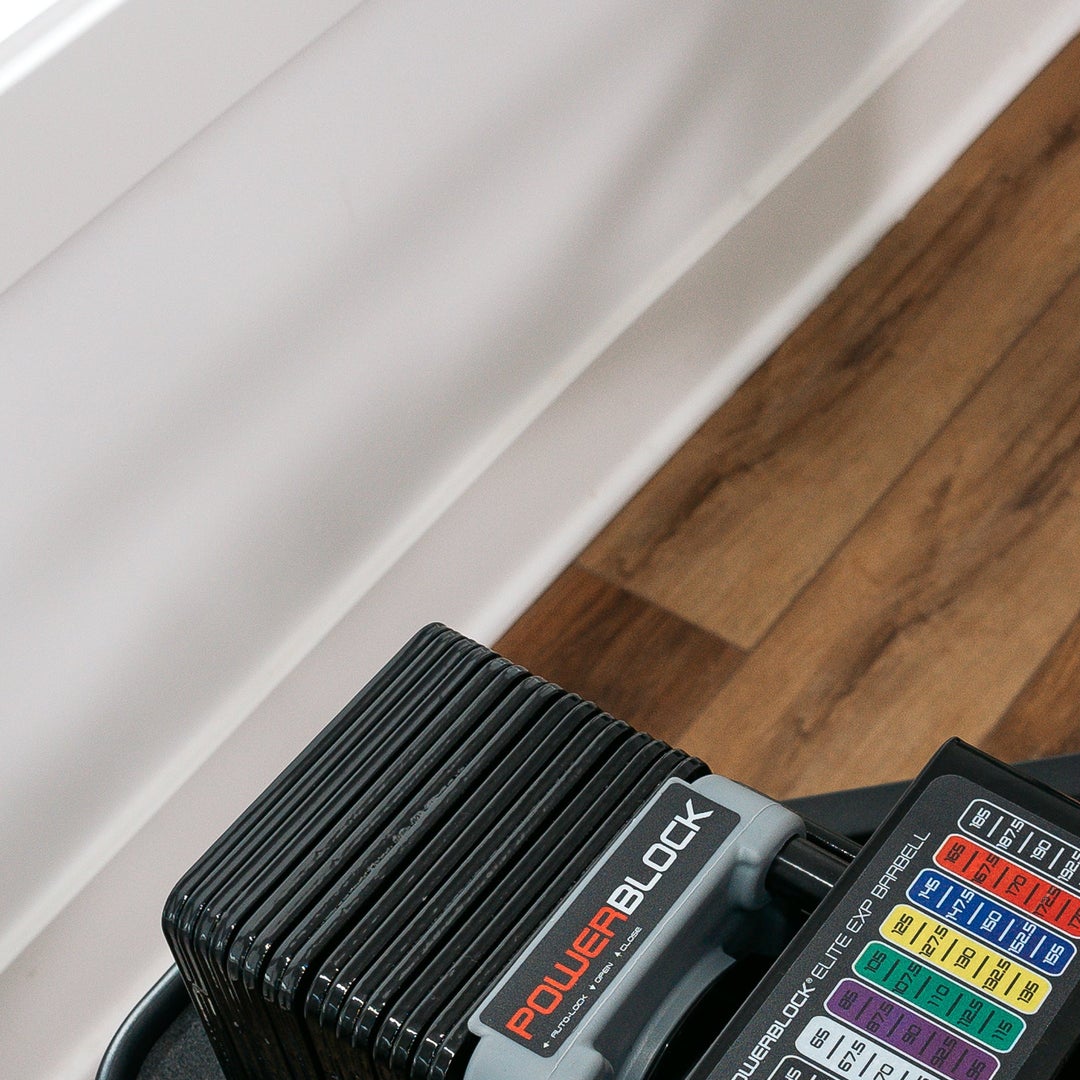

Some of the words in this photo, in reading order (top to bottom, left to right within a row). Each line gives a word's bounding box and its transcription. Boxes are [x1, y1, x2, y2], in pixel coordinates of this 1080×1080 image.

[505, 798, 714, 1040] POWERBLOCK
[550, 993, 588, 1039] AUTO-LOCK
[594, 961, 614, 984] OPEN
[619, 926, 643, 952] CLOSE
[809, 1027, 831, 1049] 65
[838, 989, 859, 1011] 85
[863, 950, 887, 973] 105
[891, 913, 914, 936] 125
[918, 877, 941, 900] 145
[944, 842, 966, 864] 165
[969, 807, 991, 829] 185
[811, 932, 852, 980] ELITE
[846, 898, 873, 933] EXP
[871, 832, 931, 900] BARBELL
[837, 1039, 866, 1072] 67.5
[865, 1001, 894, 1033] 87.5
[892, 961, 923, 995] 107.5
[919, 924, 949, 957] 127.5
[946, 889, 975, 921] 147.5
[971, 852, 1000, 884] 167.5
[996, 818, 1025, 849] 187.5
[902, 1023, 922, 1046] 90
[927, 984, 950, 1007] 110
[954, 947, 976, 969] 130
[980, 910, 1002, 932] 150
[1005, 874, 1027, 896] 170
[1030, 839, 1051, 861] 190
[957, 999, 983, 1027] 112.5
[982, 958, 1011, 992] 132.5
[1008, 921, 1037, 954] 152.5
[1033, 886, 1061, 917] 172.5
[966, 1059, 987, 1080] 95
[992, 1020, 1013, 1041] 115
[1017, 980, 1039, 1004] 135
[1043, 943, 1065, 966] 155
